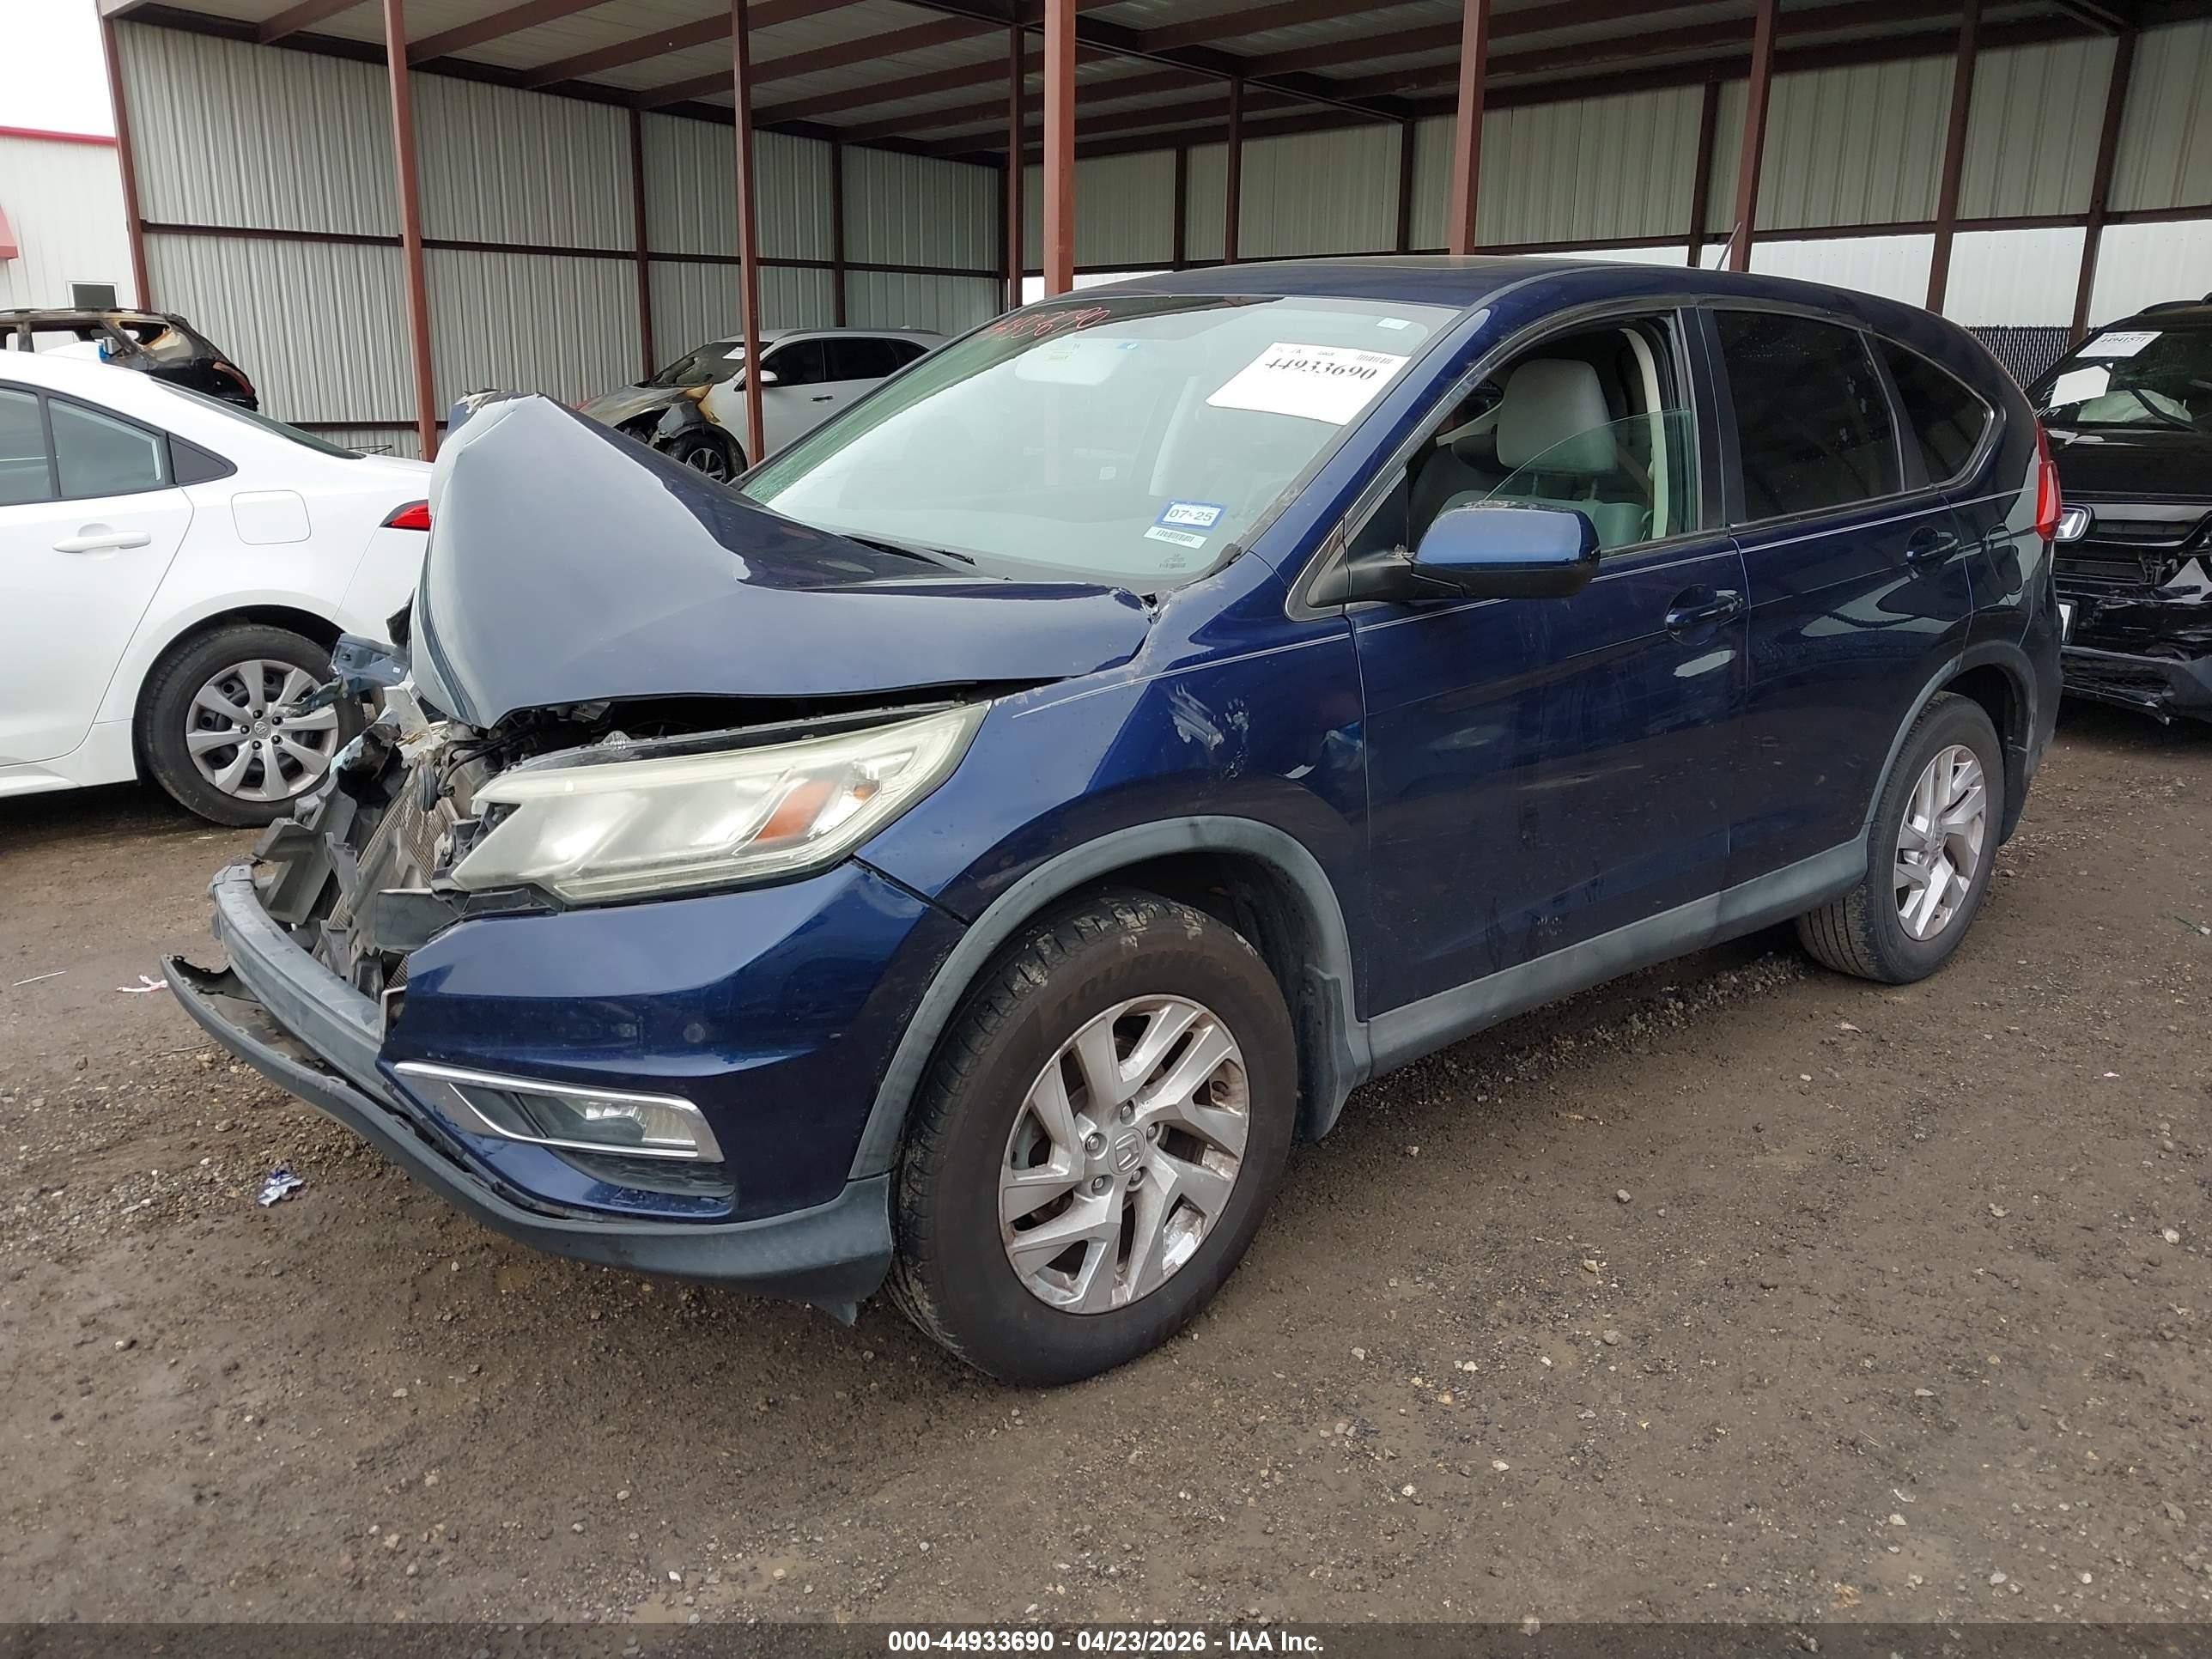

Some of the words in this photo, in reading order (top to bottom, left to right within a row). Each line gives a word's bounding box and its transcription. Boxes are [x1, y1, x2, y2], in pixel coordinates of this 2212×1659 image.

[1265, 357, 1377, 380] 44933690
[1168, 508, 1189, 518] 07
[1194, 511, 1214, 521] 25
